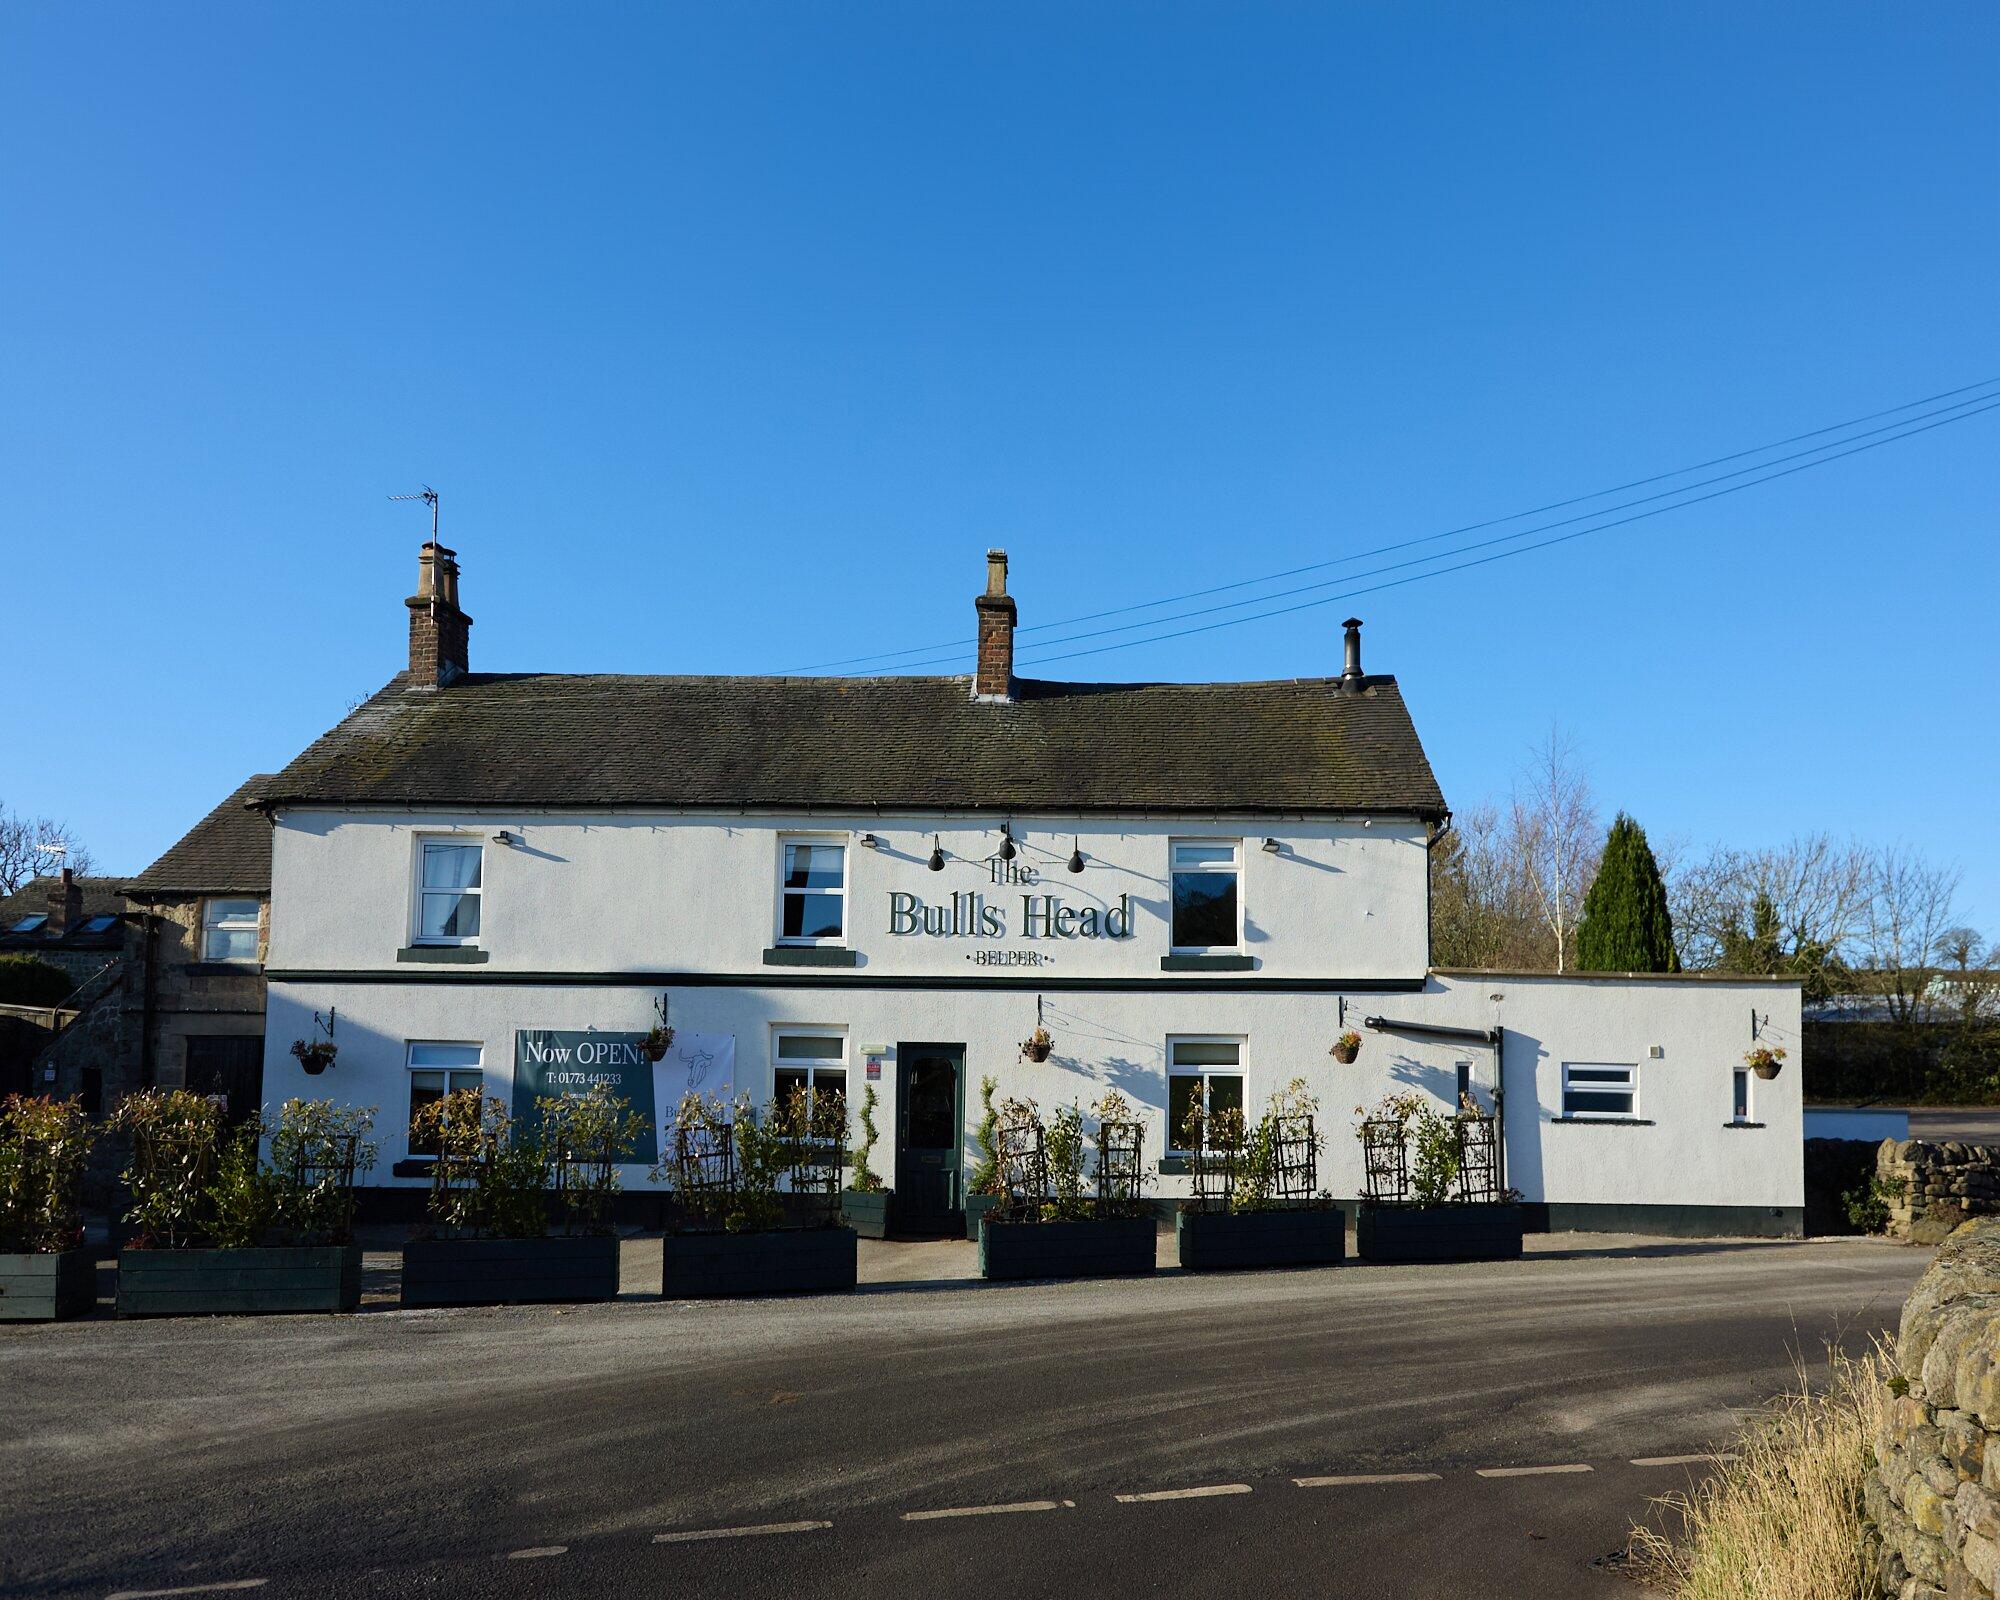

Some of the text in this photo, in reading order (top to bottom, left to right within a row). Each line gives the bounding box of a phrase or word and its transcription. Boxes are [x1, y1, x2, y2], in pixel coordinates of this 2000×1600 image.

[984, 857, 1032, 884] The
[886, 890, 1130, 938] Bulls Head
[975, 950, 1038, 966] BELPER
[524, 1041, 645, 1065] Now OPEN!
[546, 1072, 622, 1085] T: 01773 441233
